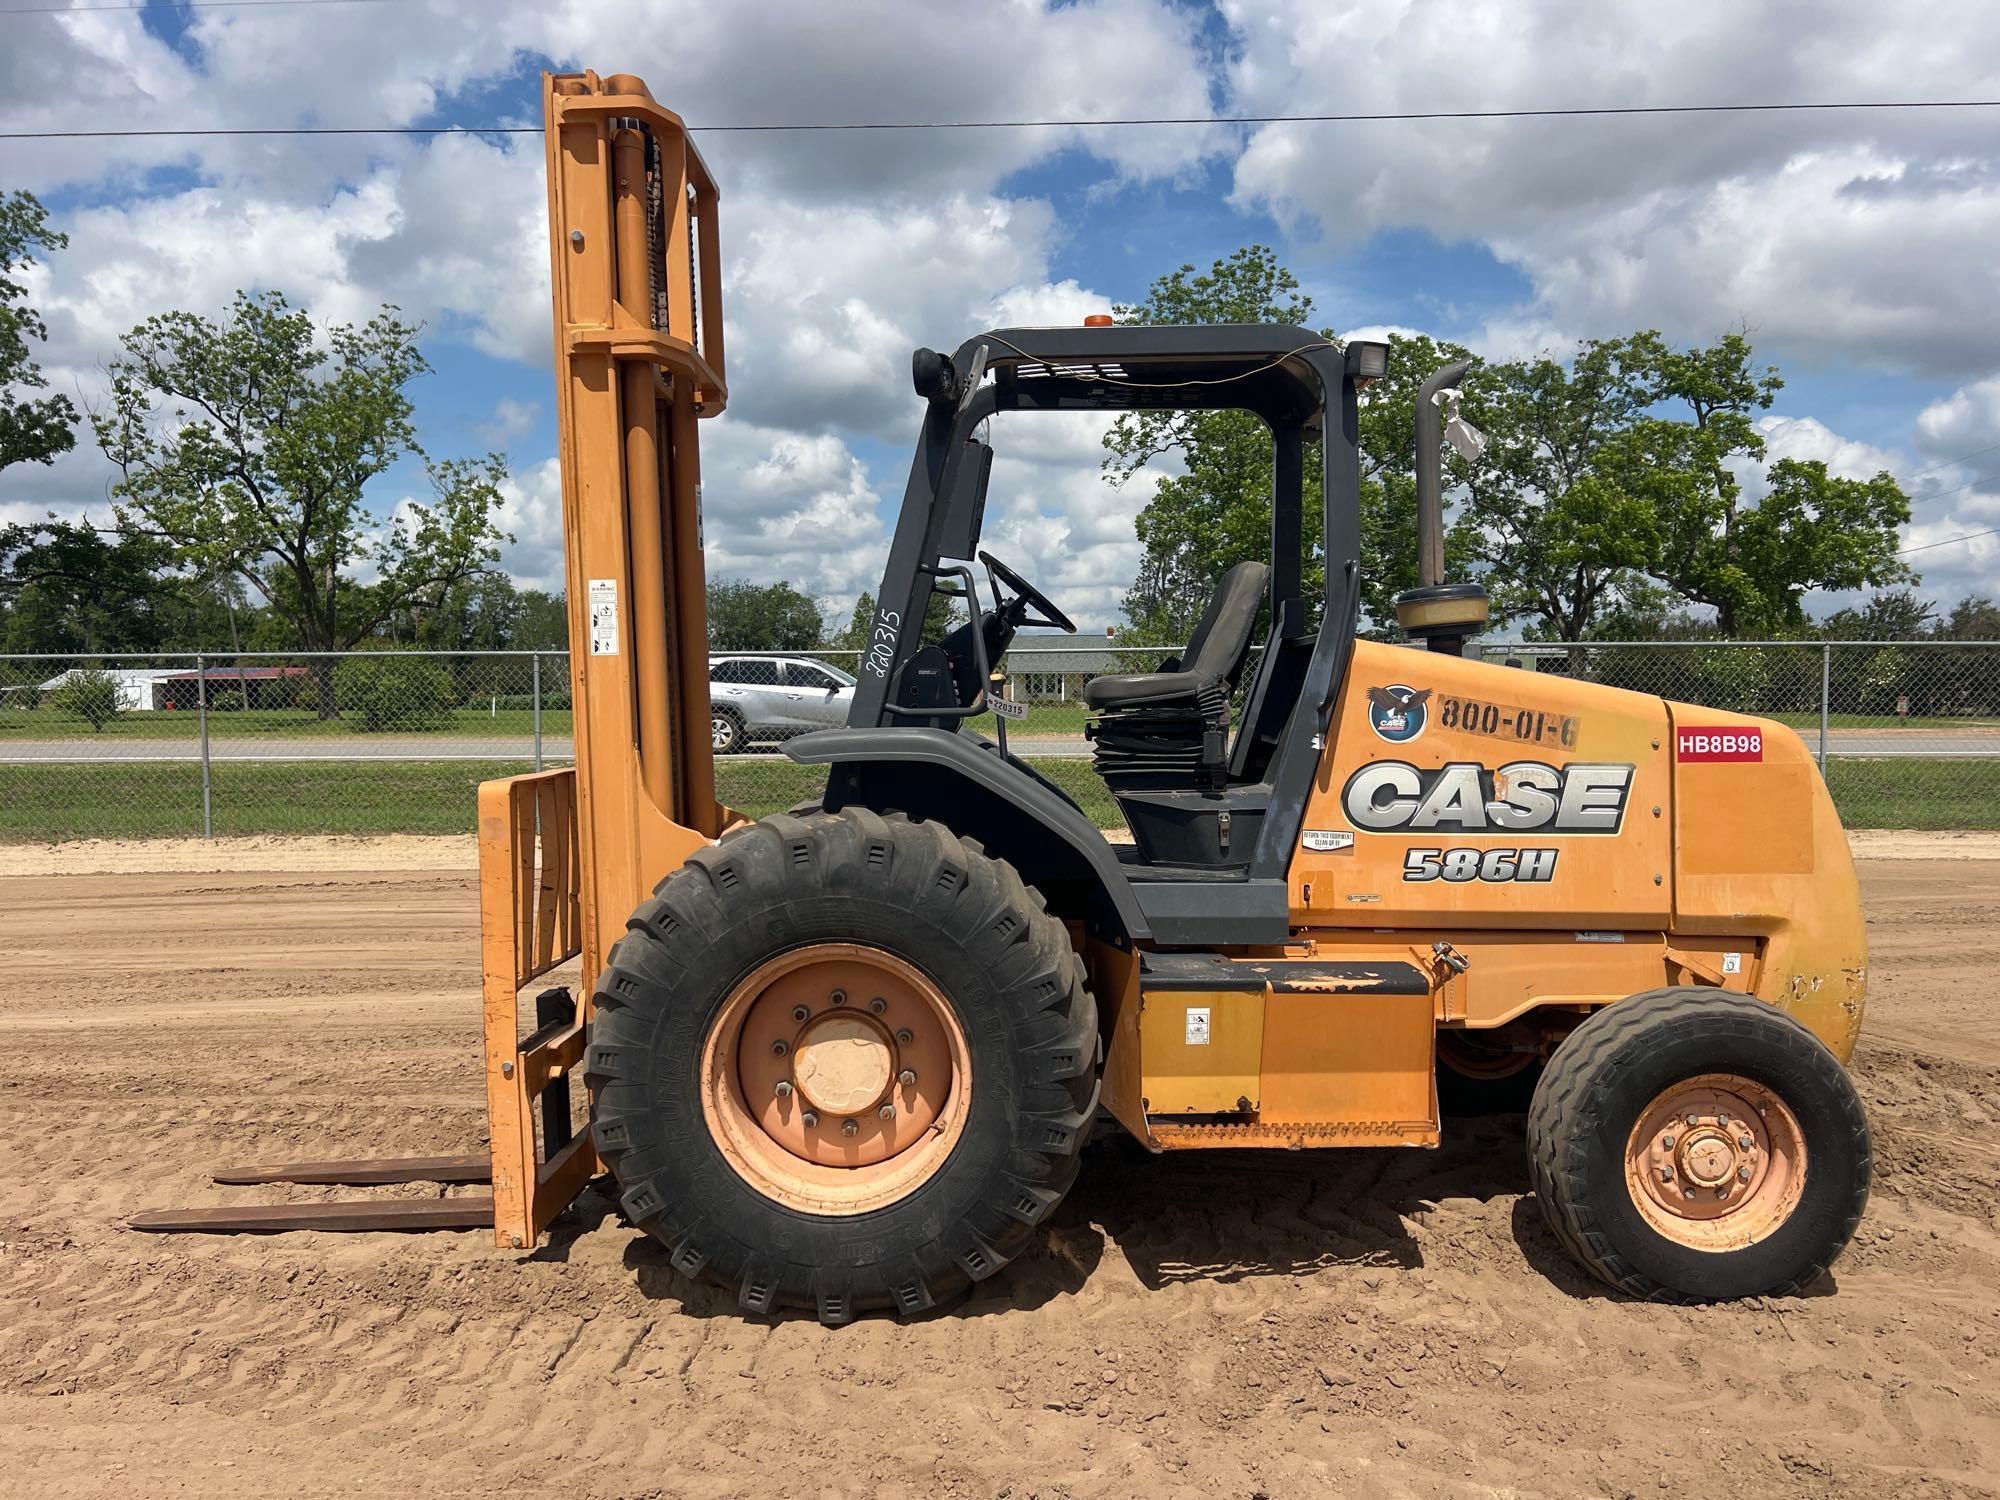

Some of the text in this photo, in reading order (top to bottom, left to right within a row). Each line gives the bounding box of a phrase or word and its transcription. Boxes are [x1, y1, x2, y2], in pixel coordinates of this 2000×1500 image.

[866, 608, 900, 678] 220315
[994, 699, 1023, 714] 220315
[1680, 736, 1761, 753] HB8B98
[1345, 763, 1632, 831] CASE
[1403, 848, 1558, 881] 586H
